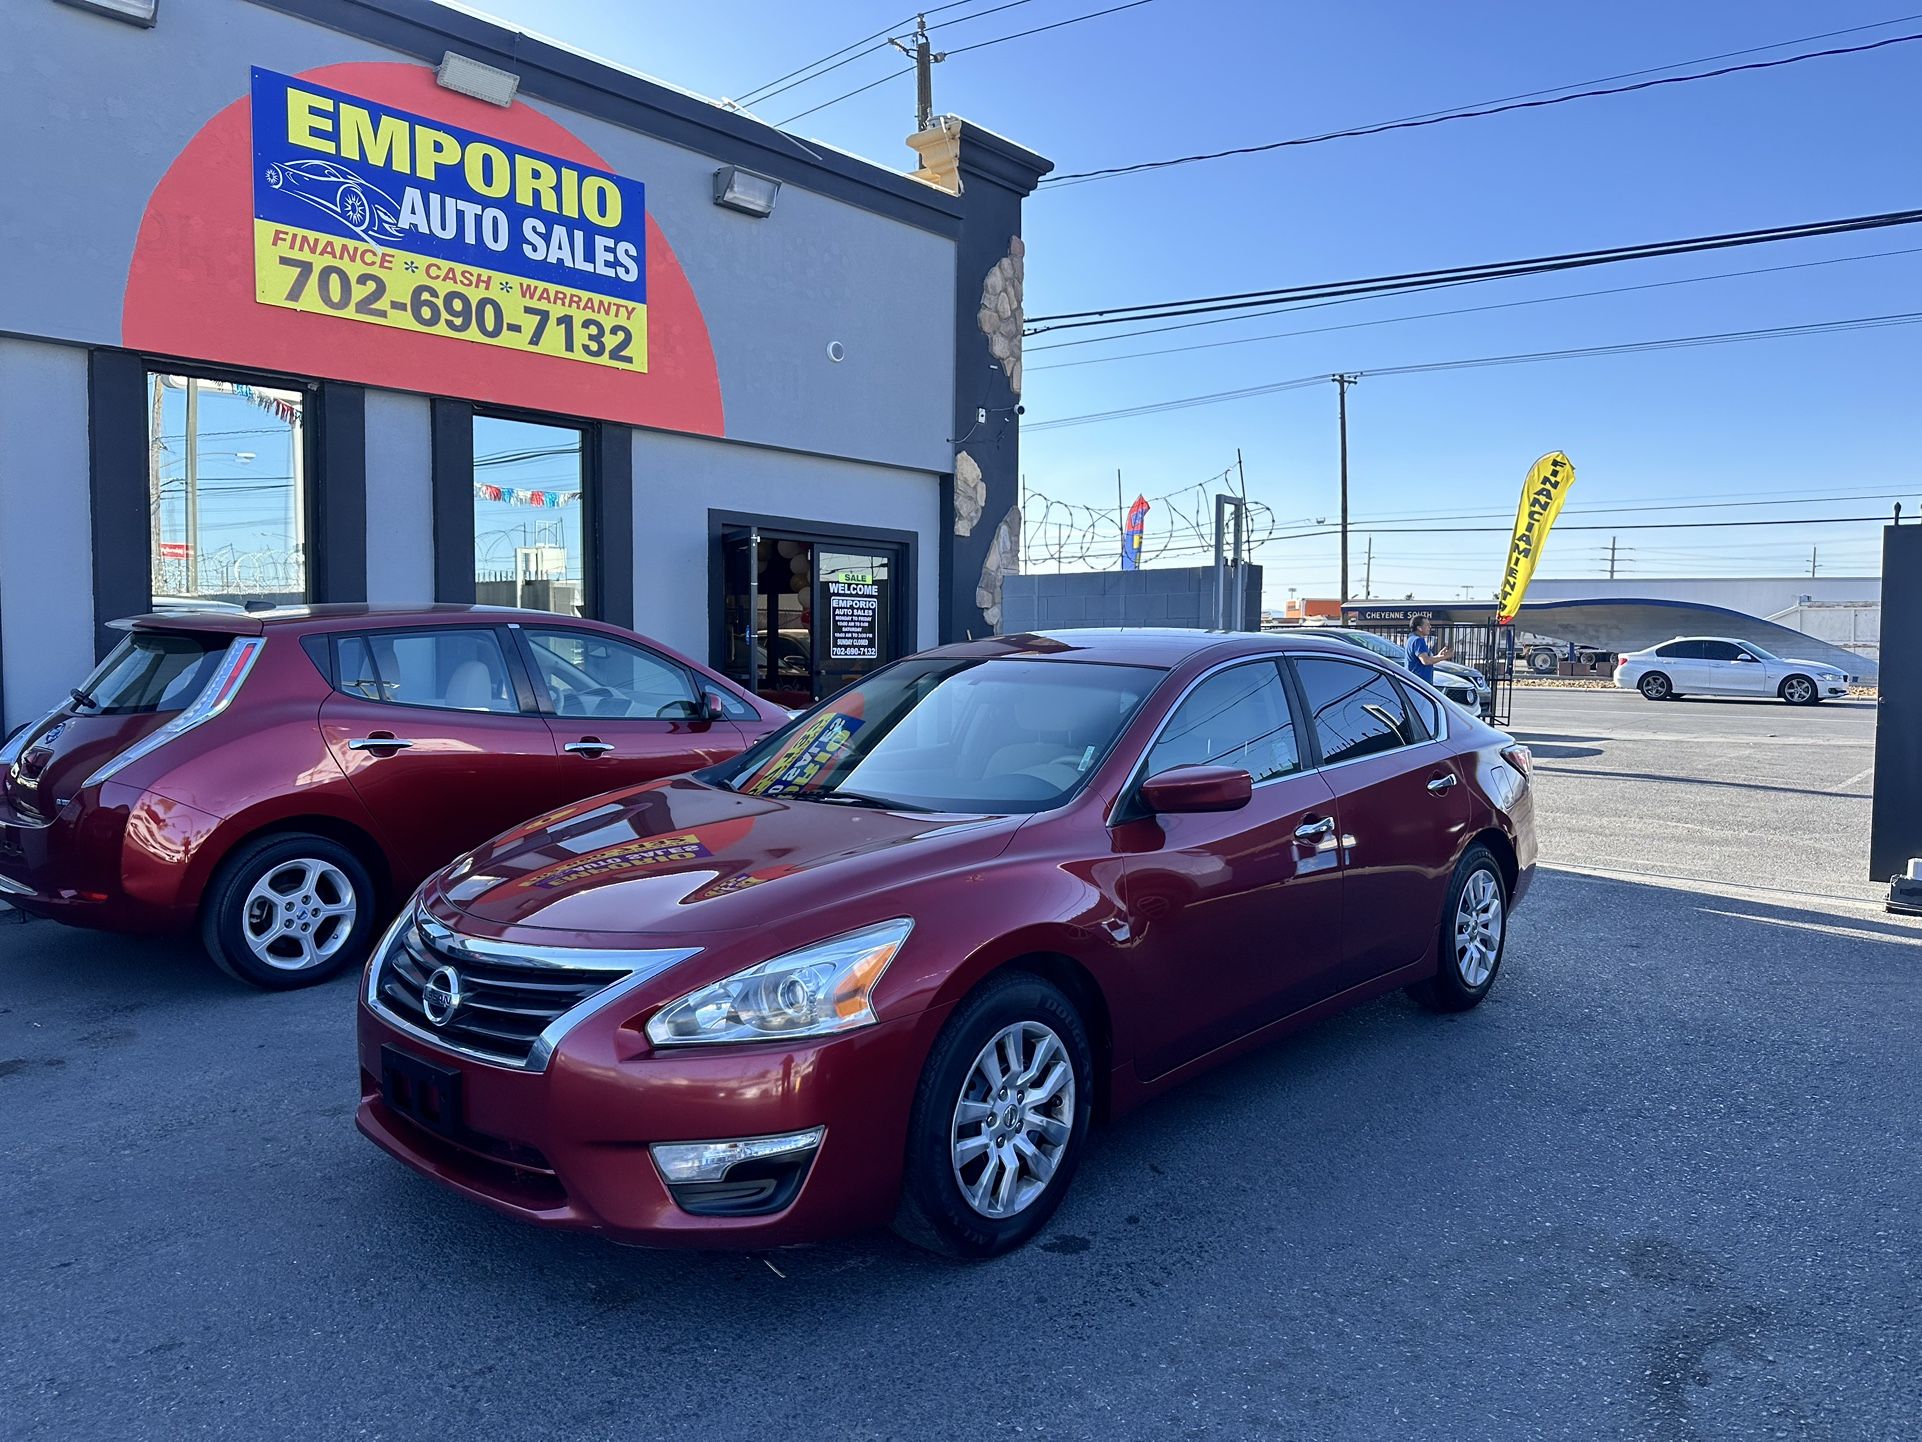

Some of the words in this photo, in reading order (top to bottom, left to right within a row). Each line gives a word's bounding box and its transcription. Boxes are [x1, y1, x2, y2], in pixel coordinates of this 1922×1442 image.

[286, 87, 623, 229] EMPORIO
[397, 187, 509, 252] AUTO
[522, 217, 639, 283] SALES
[271, 229, 395, 271] FINANCE
[424, 263, 492, 291] CASH
[519, 283, 637, 320] WARRANTY
[278, 256, 634, 364] 702-690-7132
[829, 583, 878, 595] WELCOME
[844, 574, 867, 582] SALE
[832, 600, 876, 609] EMPORIO
[1366, 611, 1404, 619] CHEYENNE
